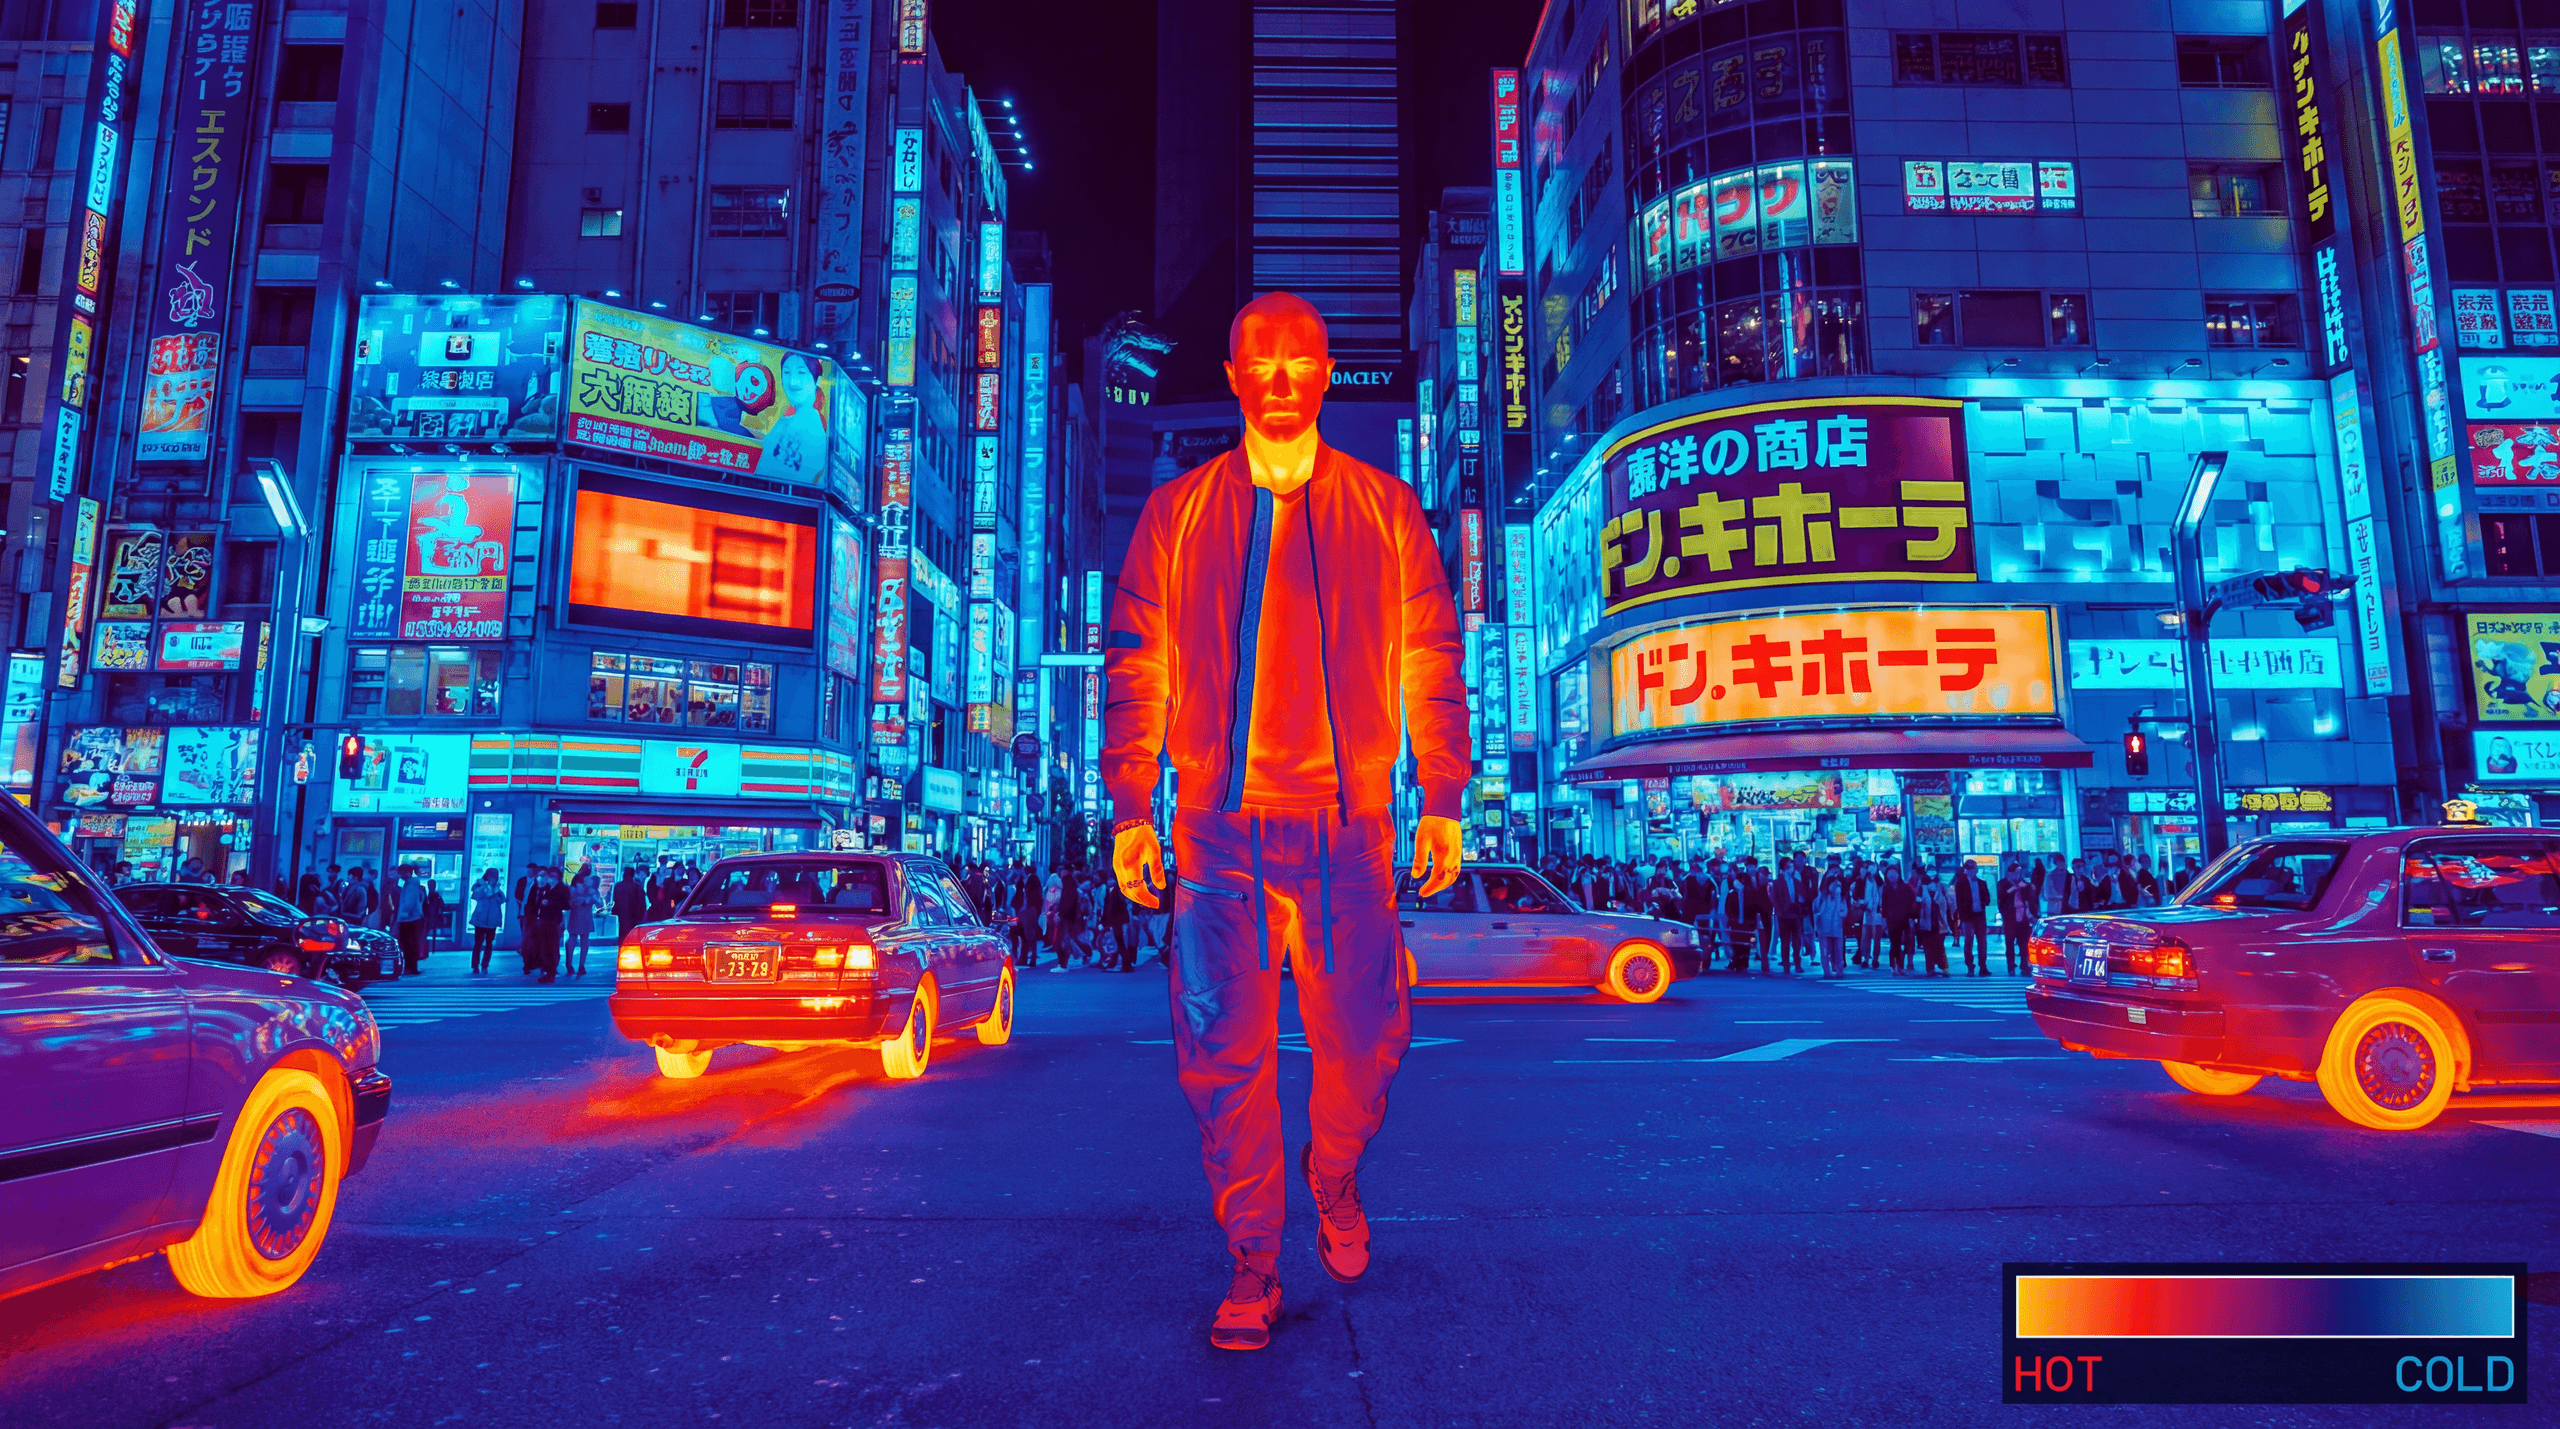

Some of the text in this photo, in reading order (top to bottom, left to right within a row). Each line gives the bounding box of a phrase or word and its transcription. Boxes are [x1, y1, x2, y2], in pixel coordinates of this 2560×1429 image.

[1637, 628, 1998, 713] ドン.キホーテ
